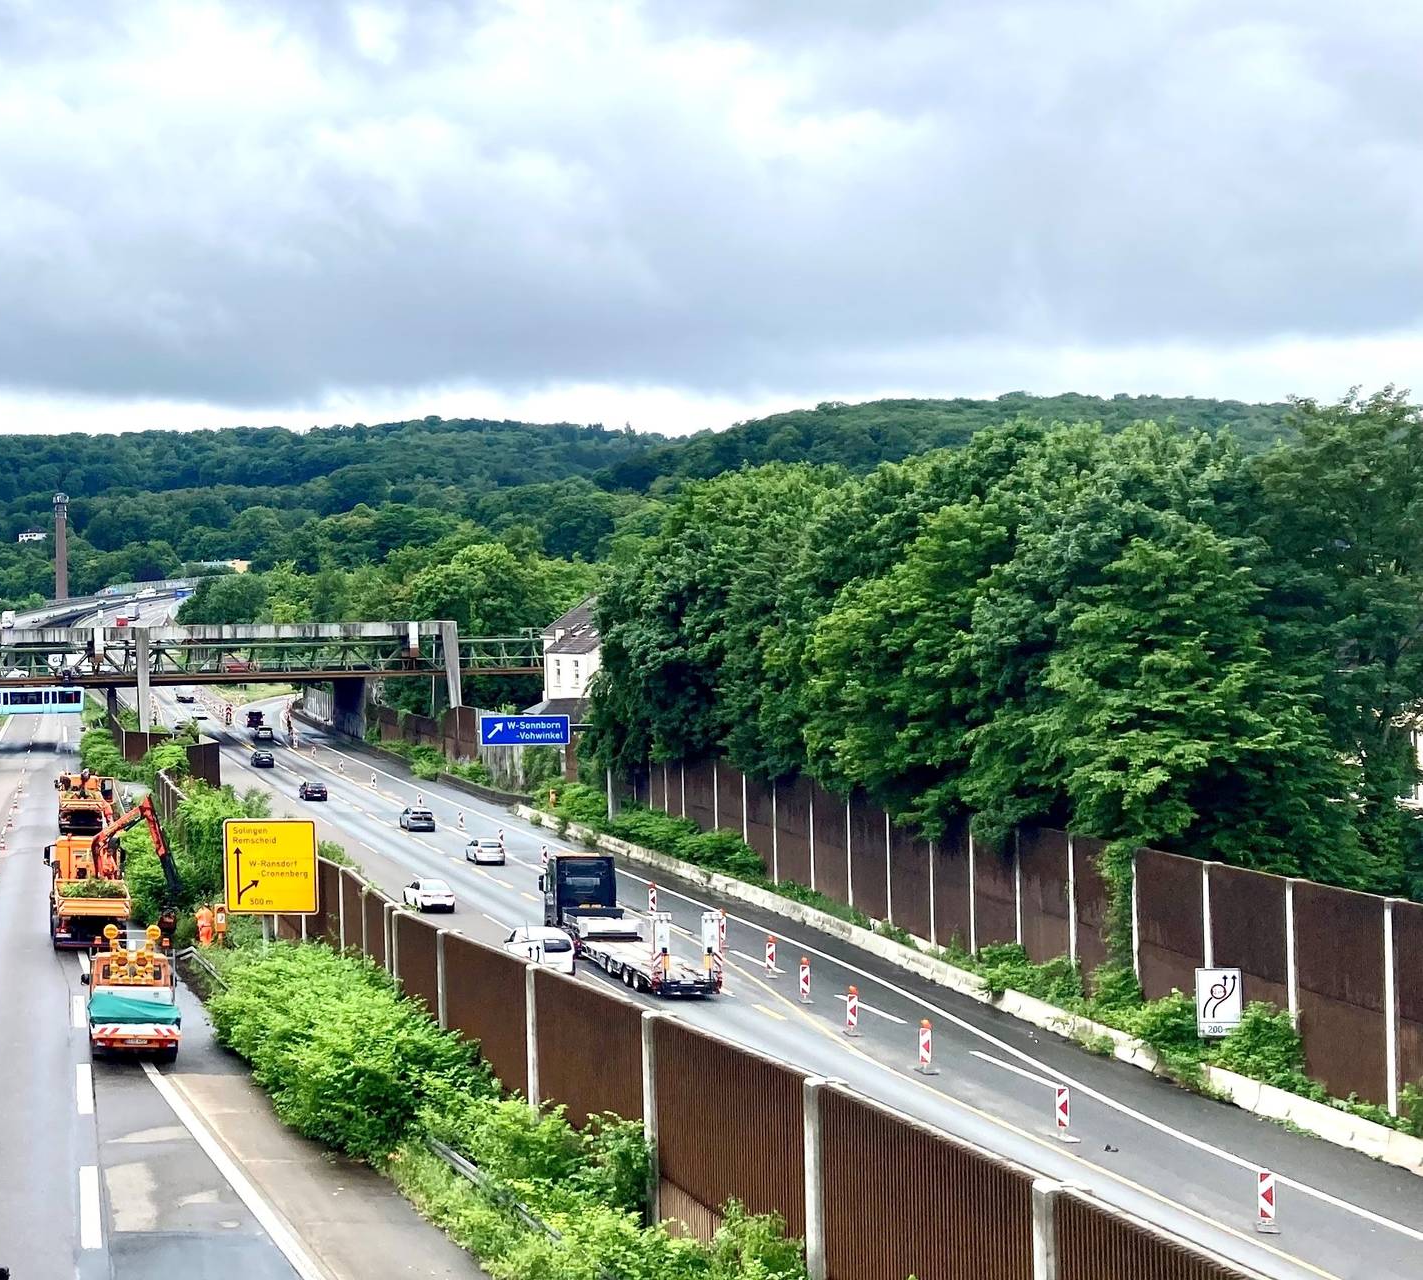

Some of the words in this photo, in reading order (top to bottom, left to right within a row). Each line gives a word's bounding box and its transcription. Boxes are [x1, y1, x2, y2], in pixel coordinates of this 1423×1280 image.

[507, 722, 561, 730] W-Sonnborn
[233, 827, 268, 835] Solingen
[1208, 1026, 1223, 1034] 200
